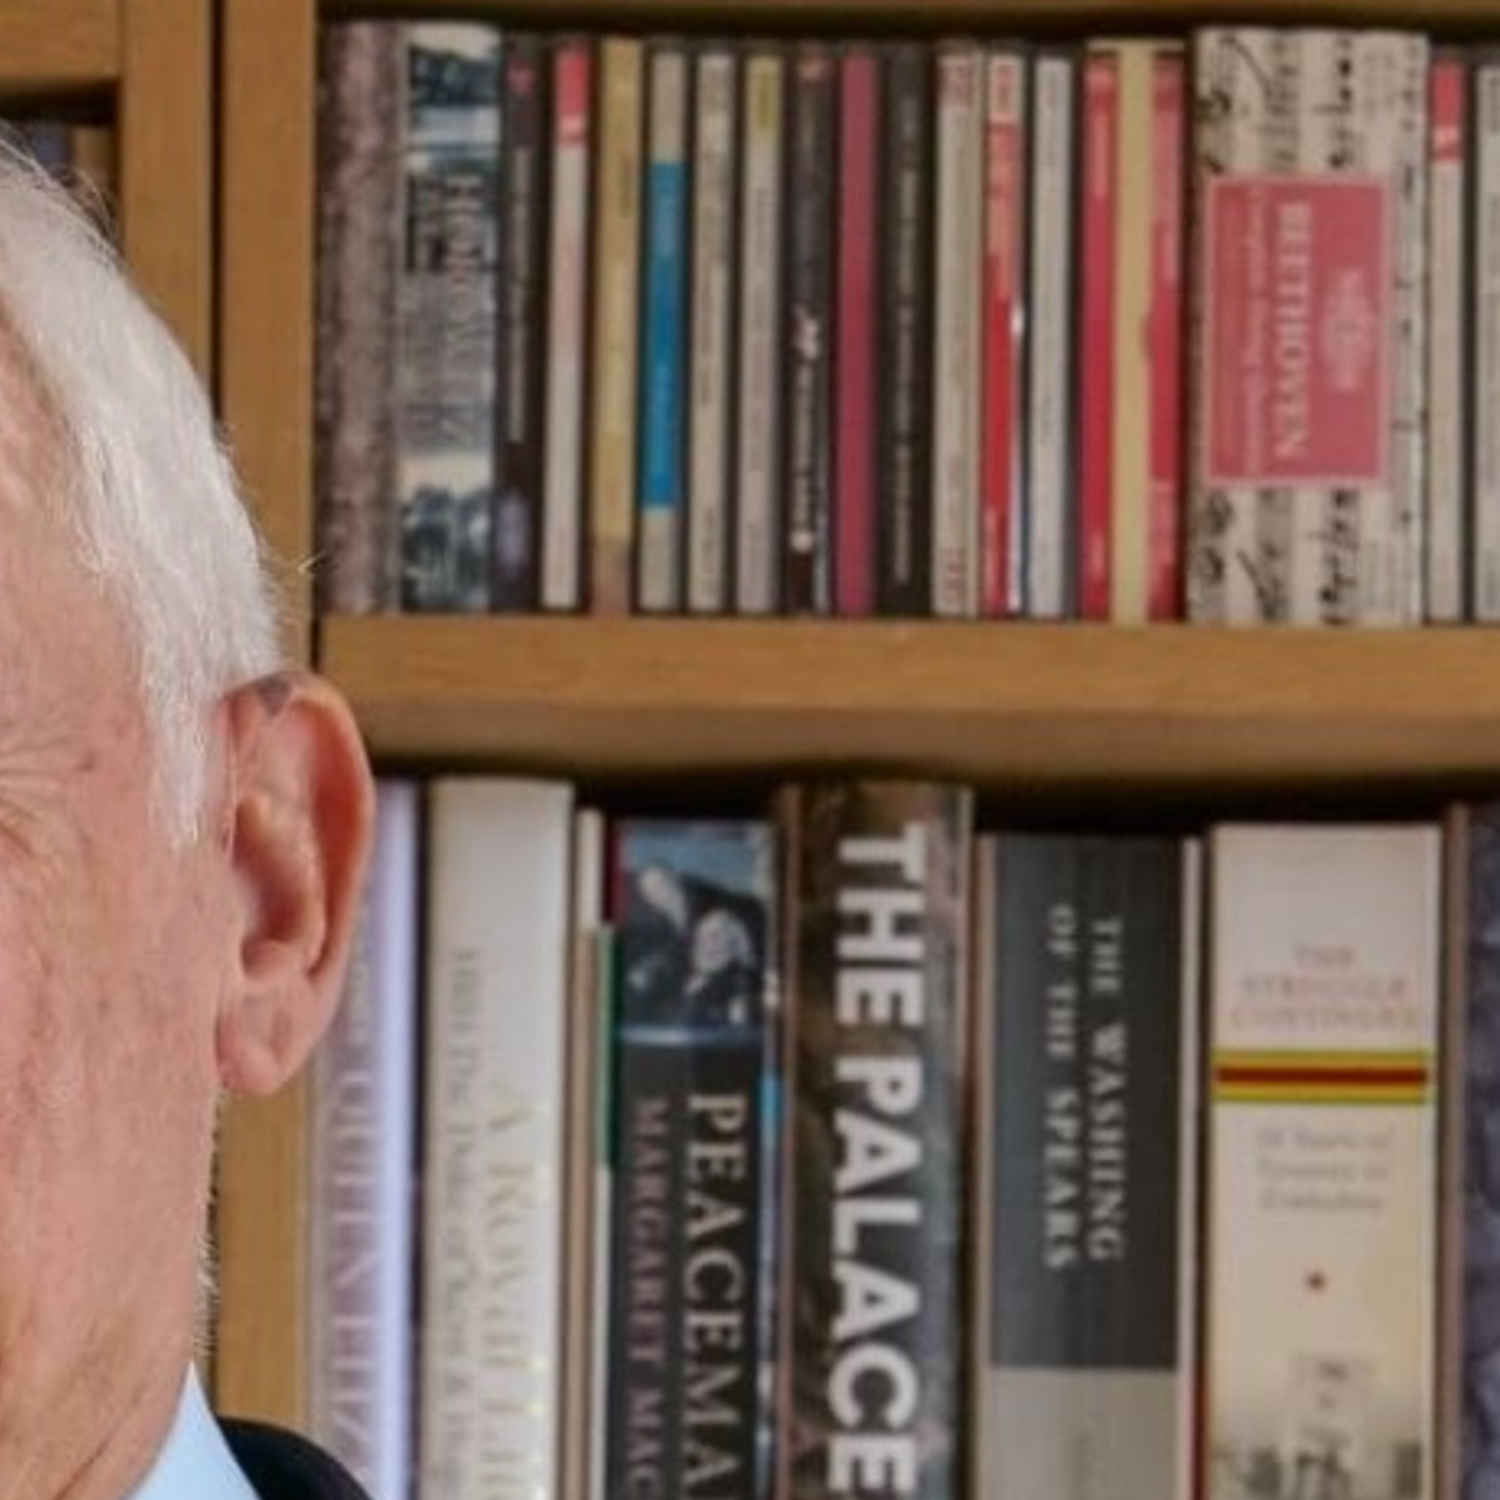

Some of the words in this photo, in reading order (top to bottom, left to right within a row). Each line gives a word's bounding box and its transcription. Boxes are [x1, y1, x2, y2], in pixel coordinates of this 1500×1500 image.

[1272, 201, 1312, 460] BEETHOVEN
[832, 825, 925, 1026] THE
[1042, 901, 1077, 959] OF
[1042, 981, 1077, 1063] THE
[1088, 916, 1126, 997] THE
[627, 1100, 669, 1364] MARGARET
[1042, 1084, 1077, 1272] SPEARS
[1087, 1021, 1127, 1263] WASHING
[826, 1054, 922, 1493] PALACE
